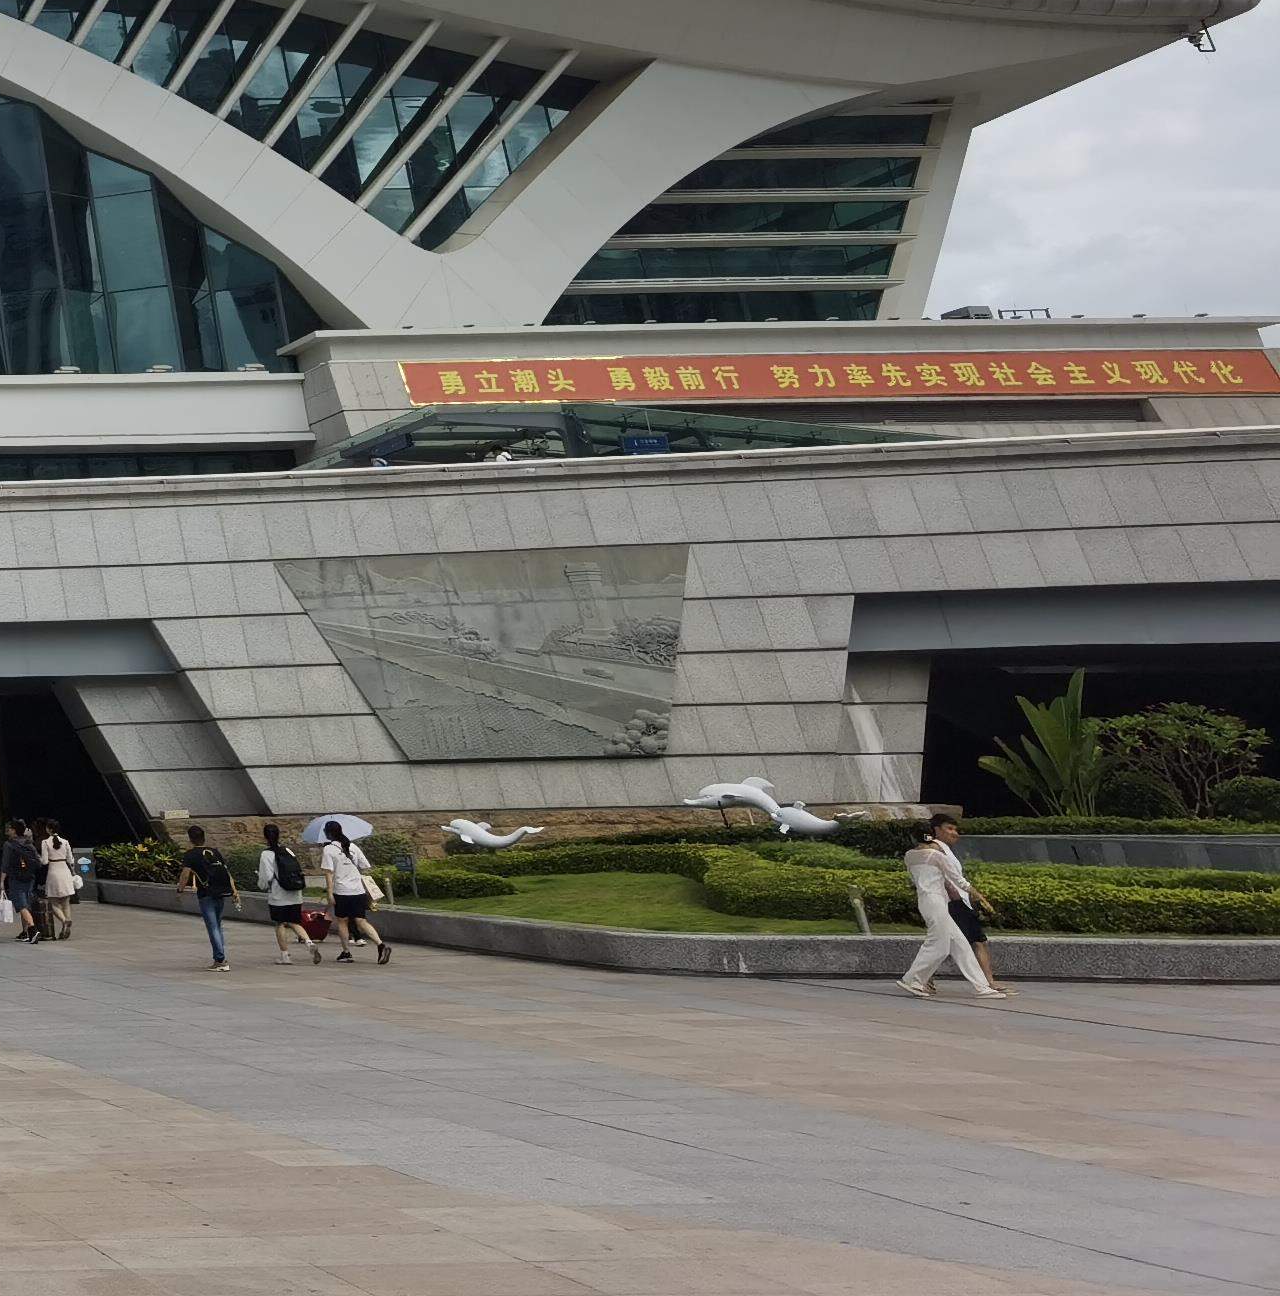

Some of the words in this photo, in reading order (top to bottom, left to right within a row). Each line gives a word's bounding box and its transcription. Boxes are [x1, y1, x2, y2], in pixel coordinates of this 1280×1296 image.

[438, 368, 577, 395] 勇立潮头
[606, 366, 742, 392] 勇毅前行
[770, 360, 1245, 389] 努力率先实现社会主义现代化
